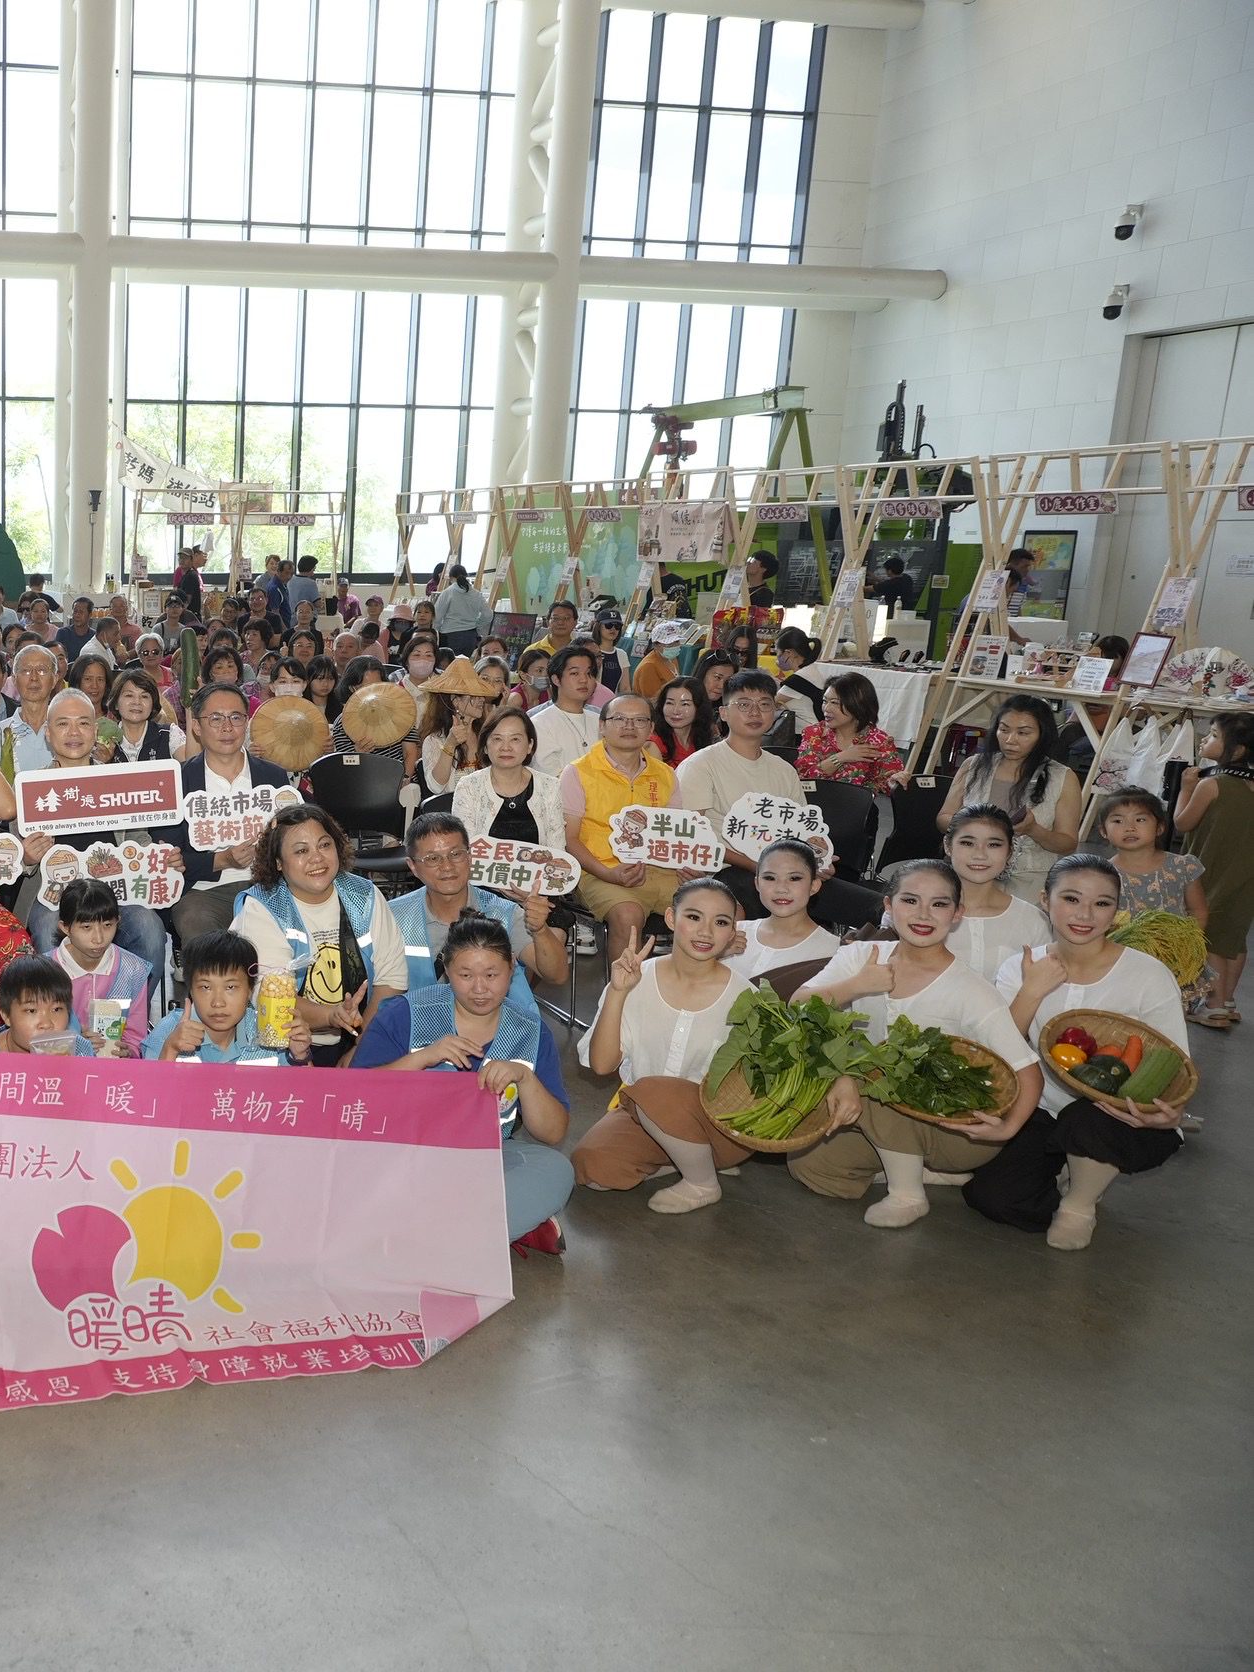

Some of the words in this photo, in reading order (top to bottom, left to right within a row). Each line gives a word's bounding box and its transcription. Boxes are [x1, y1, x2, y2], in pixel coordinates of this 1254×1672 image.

[124, 452, 156, 485] 乾媽
[63, 786, 96, 808] 樹德
[99, 790, 164, 808] SHUTER
[186, 789, 273, 818] 傳統市場
[39, 823, 54, 831] 1969
[54, 822, 77, 831] always
[78, 820, 95, 828] there
[107, 818, 119, 826] you
[123, 812, 176, 823] 一直就在你身邊
[194, 815, 264, 846] 藝術節
[651, 813, 695, 839] 半山
[470, 838, 514, 862] 全民
[67, 1283, 192, 1355] 暖晴
[203, 1309, 423, 1345] 社會福利協會
